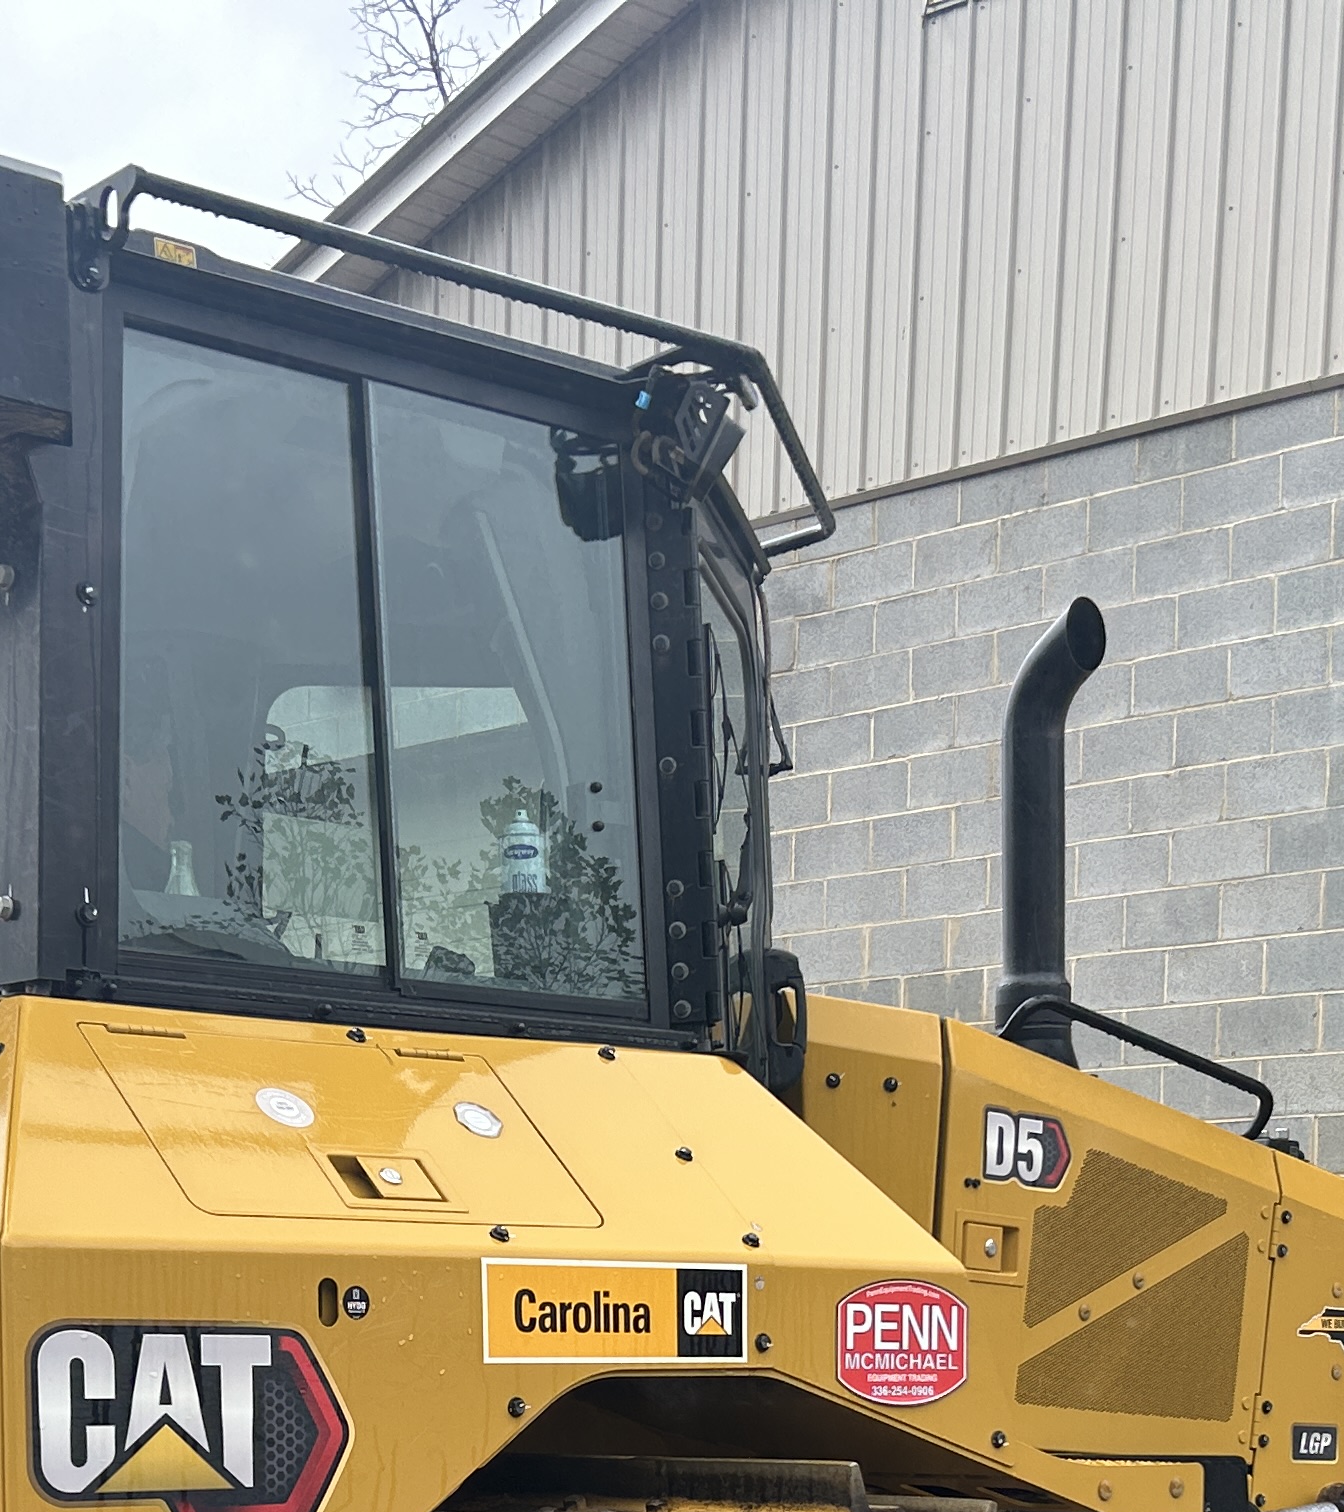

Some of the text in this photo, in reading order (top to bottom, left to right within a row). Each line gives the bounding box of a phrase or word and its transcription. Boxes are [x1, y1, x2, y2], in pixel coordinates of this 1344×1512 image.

[985, 1111, 1044, 1182] D5
[514, 1288, 737, 1336] Carolina CAT
[846, 1303, 958, 1350] PENN
[844, 1353, 958, 1370] MCMICHAEL
[37, 1329, 272, 1493] CAT
[1299, 1431, 1332, 1455] LGP
